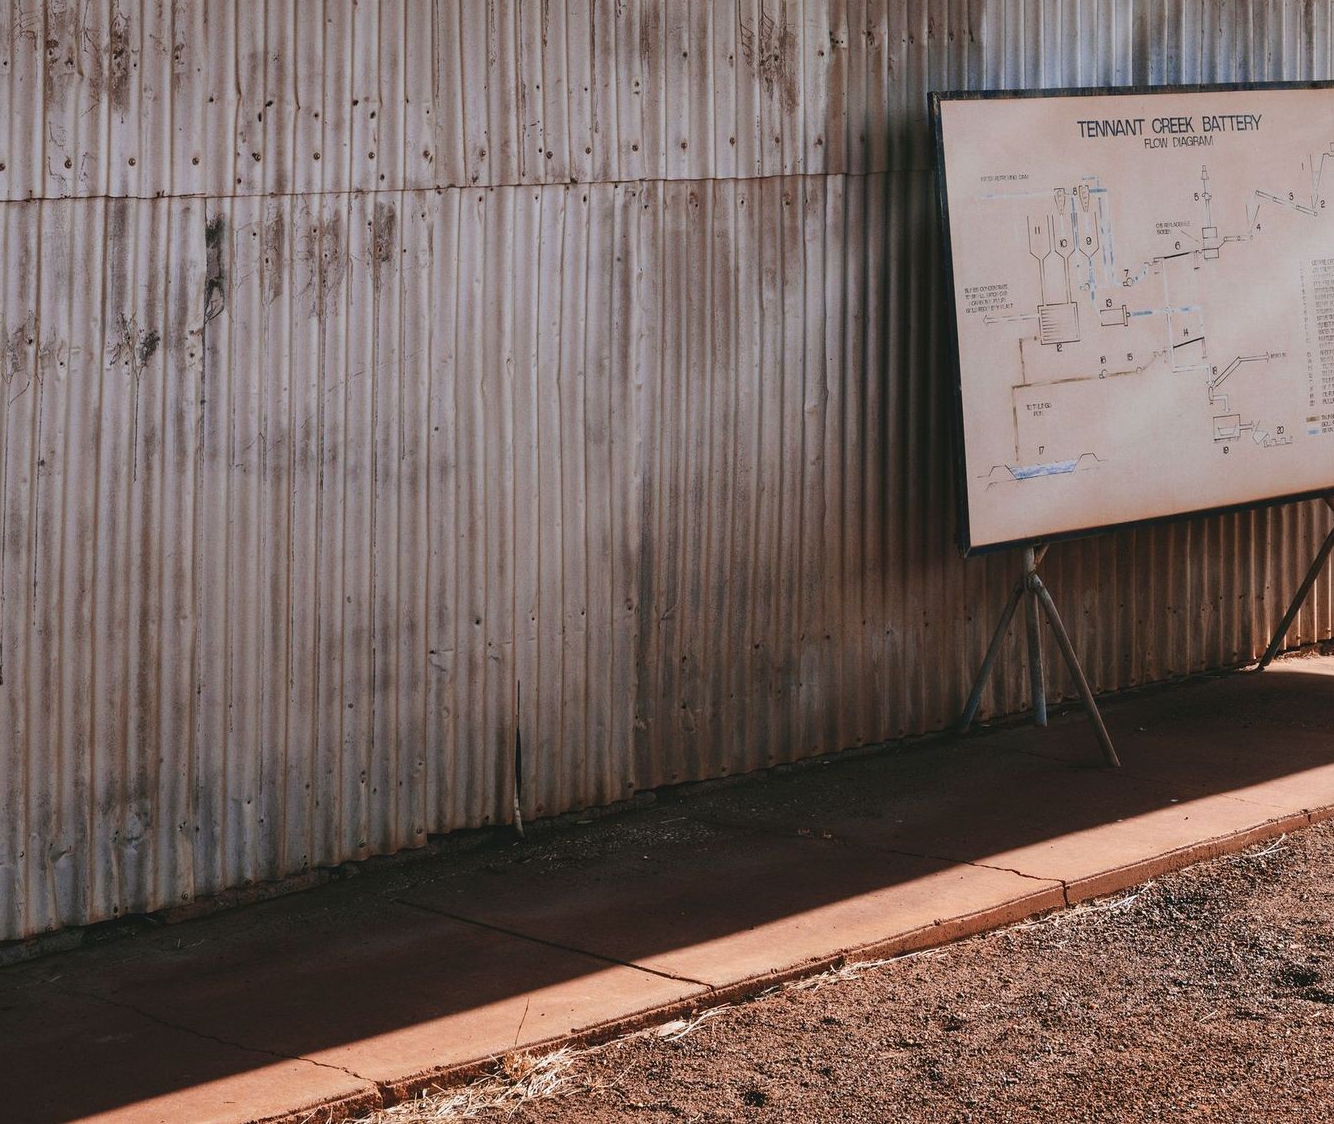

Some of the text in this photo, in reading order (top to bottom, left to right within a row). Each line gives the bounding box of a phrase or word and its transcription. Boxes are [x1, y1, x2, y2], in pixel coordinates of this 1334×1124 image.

[1077, 114, 1262, 138] TENNANT CREEK BATTERY
[1144, 135, 1214, 149] FLOW DIAGRAM
[1288, 192, 1294, 201] 3
[1320, 200, 1326, 208] 2
[1085, 236, 1092, 245] 9
[1174, 241, 1180, 250] 6
